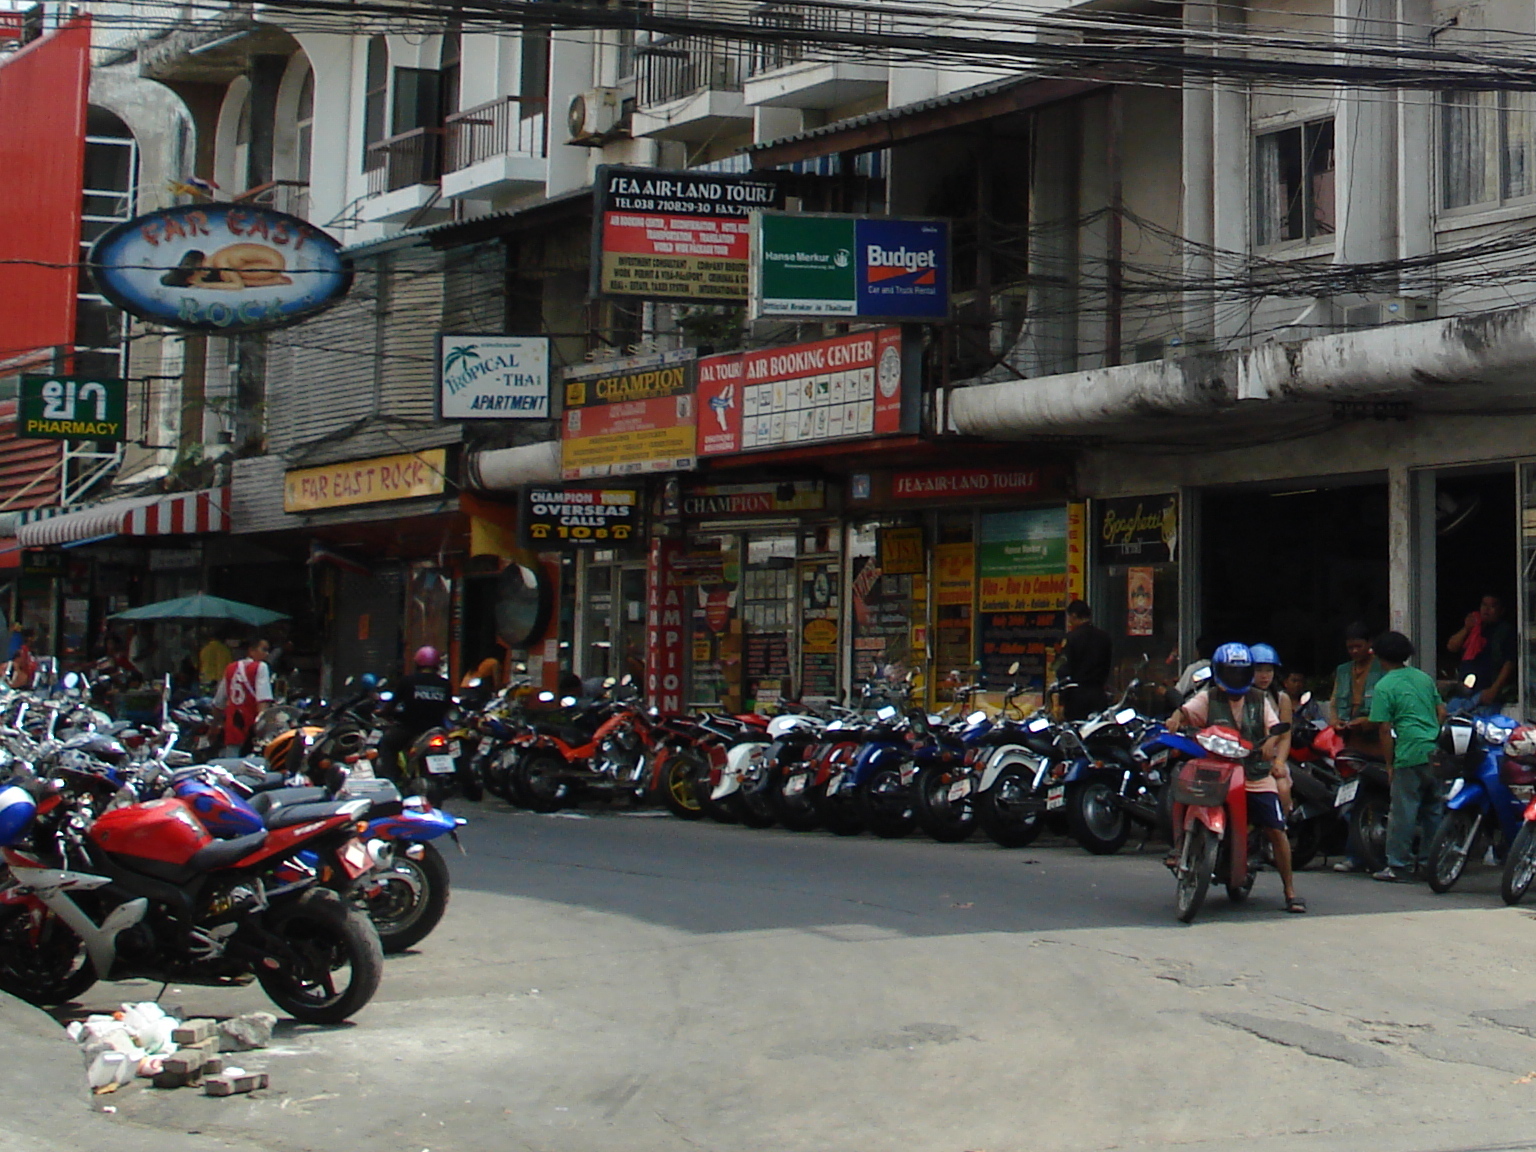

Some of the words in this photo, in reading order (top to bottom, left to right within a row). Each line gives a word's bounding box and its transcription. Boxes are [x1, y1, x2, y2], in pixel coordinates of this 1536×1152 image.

[609, 177, 641, 194] SEA
[725, 185, 776, 202] TOURS
[141, 210, 210, 246] FAR
[226, 209, 313, 251] EAST
[867, 245, 936, 273] Budget
[177, 297, 285, 327] ROCK
[747, 361, 769, 379] AIR
[770, 349, 825, 376] BOOKING
[827, 340, 874, 367] CENTER
[444, 354, 520, 395] TROPICAL
[595, 367, 686, 399] CHAMPION
[42, 380, 107, 421] ยา
[470, 395, 547, 410] APARTMENT
[28, 420, 118, 435] PHARMACY
[301, 475, 329, 501] FAR
[333, 468, 375, 498] EAST
[380, 461, 425, 491] ROCK
[993, 473, 1034, 487] TOURS
[530, 492, 593, 504] CHAMPION
[532, 504, 630, 517] OVERSEAS
[683, 494, 773, 515] CHAMPION
[557, 526, 592, 538] 10
[560, 516, 606, 527] CALLS
[1103, 503, 1163, 544] Spaghetti
[414, 691, 446, 702] POLICE
